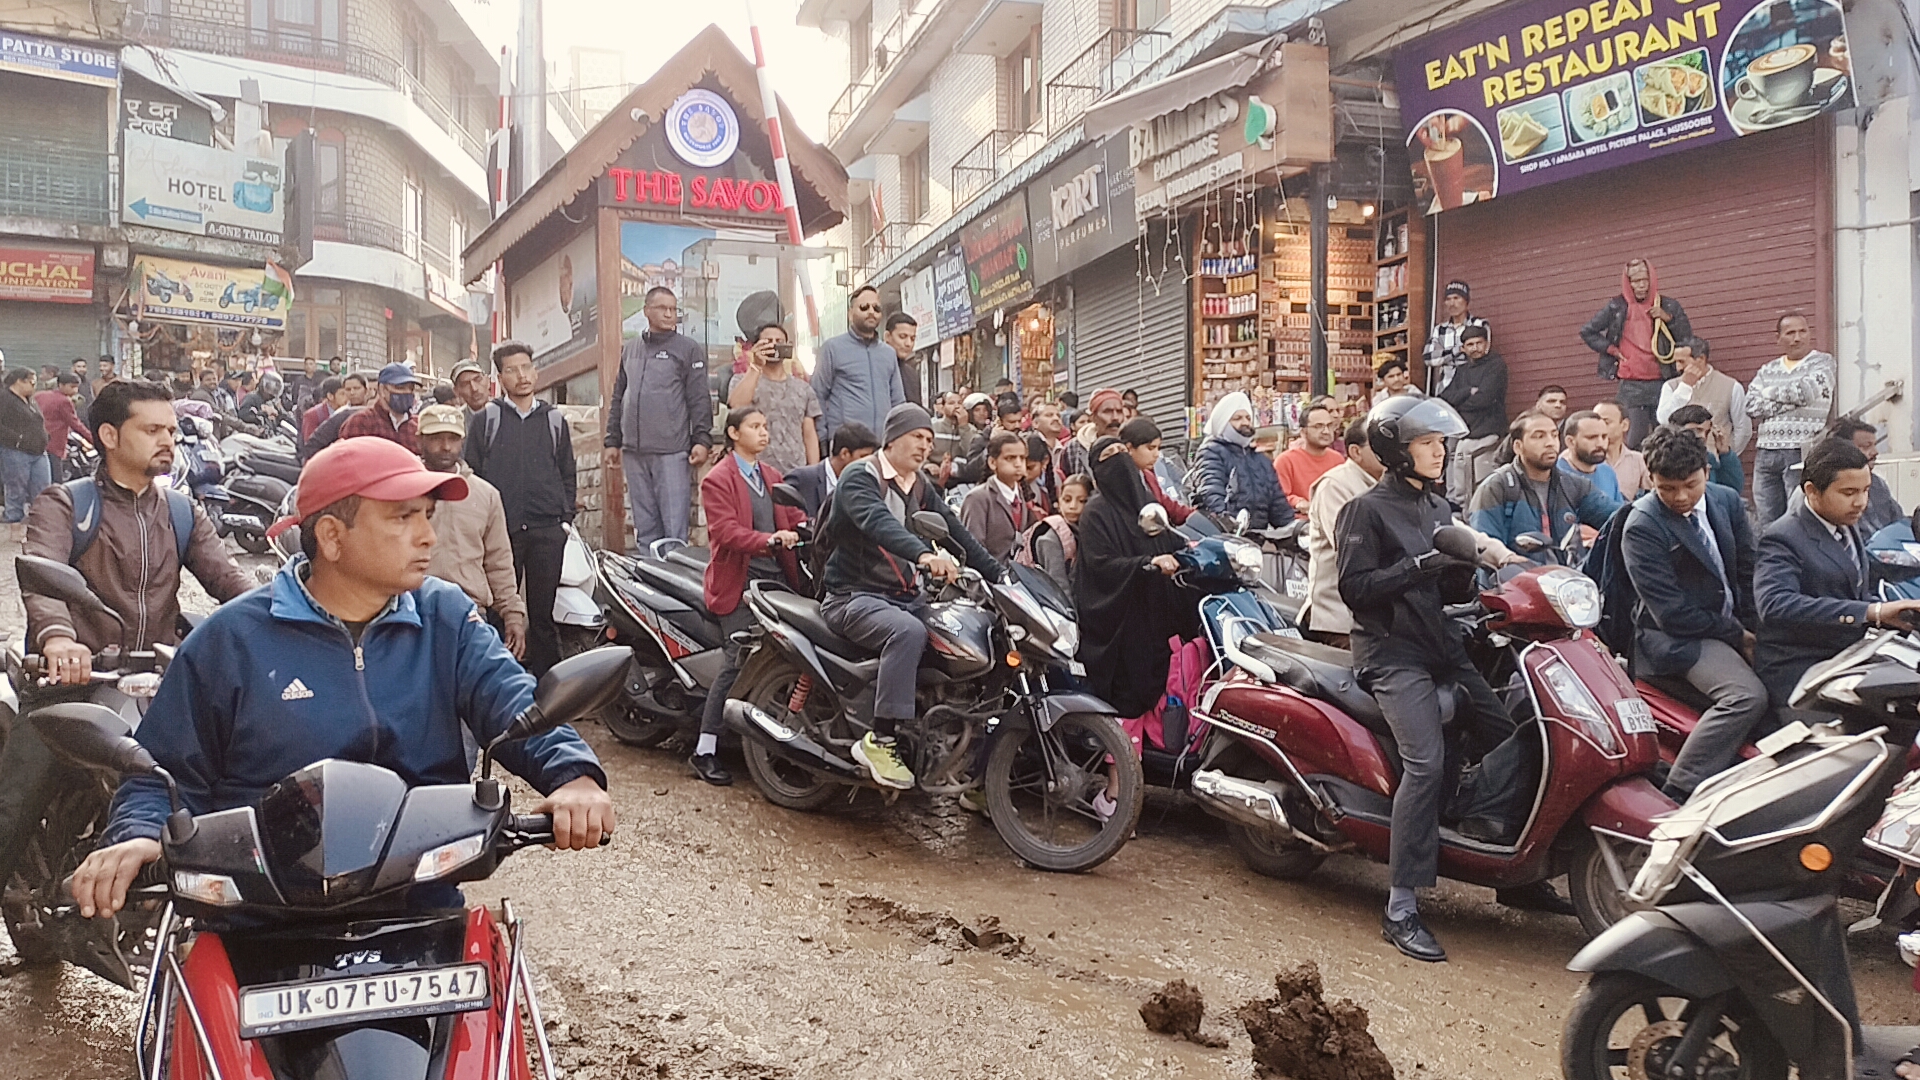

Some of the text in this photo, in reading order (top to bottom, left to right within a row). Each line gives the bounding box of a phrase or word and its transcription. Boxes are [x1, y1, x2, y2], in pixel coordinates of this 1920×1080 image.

[2, 37, 55, 60] PATTA
[61, 47, 116, 69] STORE
[1424, 34, 1511, 91] EAT'N
[1483, 2, 1721, 108] RESTAURANT
[1181, 132, 1219, 168] HOUSE
[1519, 163, 1538, 175] SHOP
[1586, 143, 1608, 156] HOTEL
[1608, 136, 1638, 151] PICTURE
[1667, 115, 1713, 136] MUSSOORIE
[168, 177, 227, 203] HOTEL
[609, 167, 785, 213] THE SAVOY
[198, 202, 215, 214] SPA
[208, 223, 280, 245] A-ONE TAILOR
[1060, 215, 1107, 250] PERFUMES
[189, 267, 226, 281] Avani
[281, 690, 314, 701] adidas
[335, 950, 382, 968] TVS
